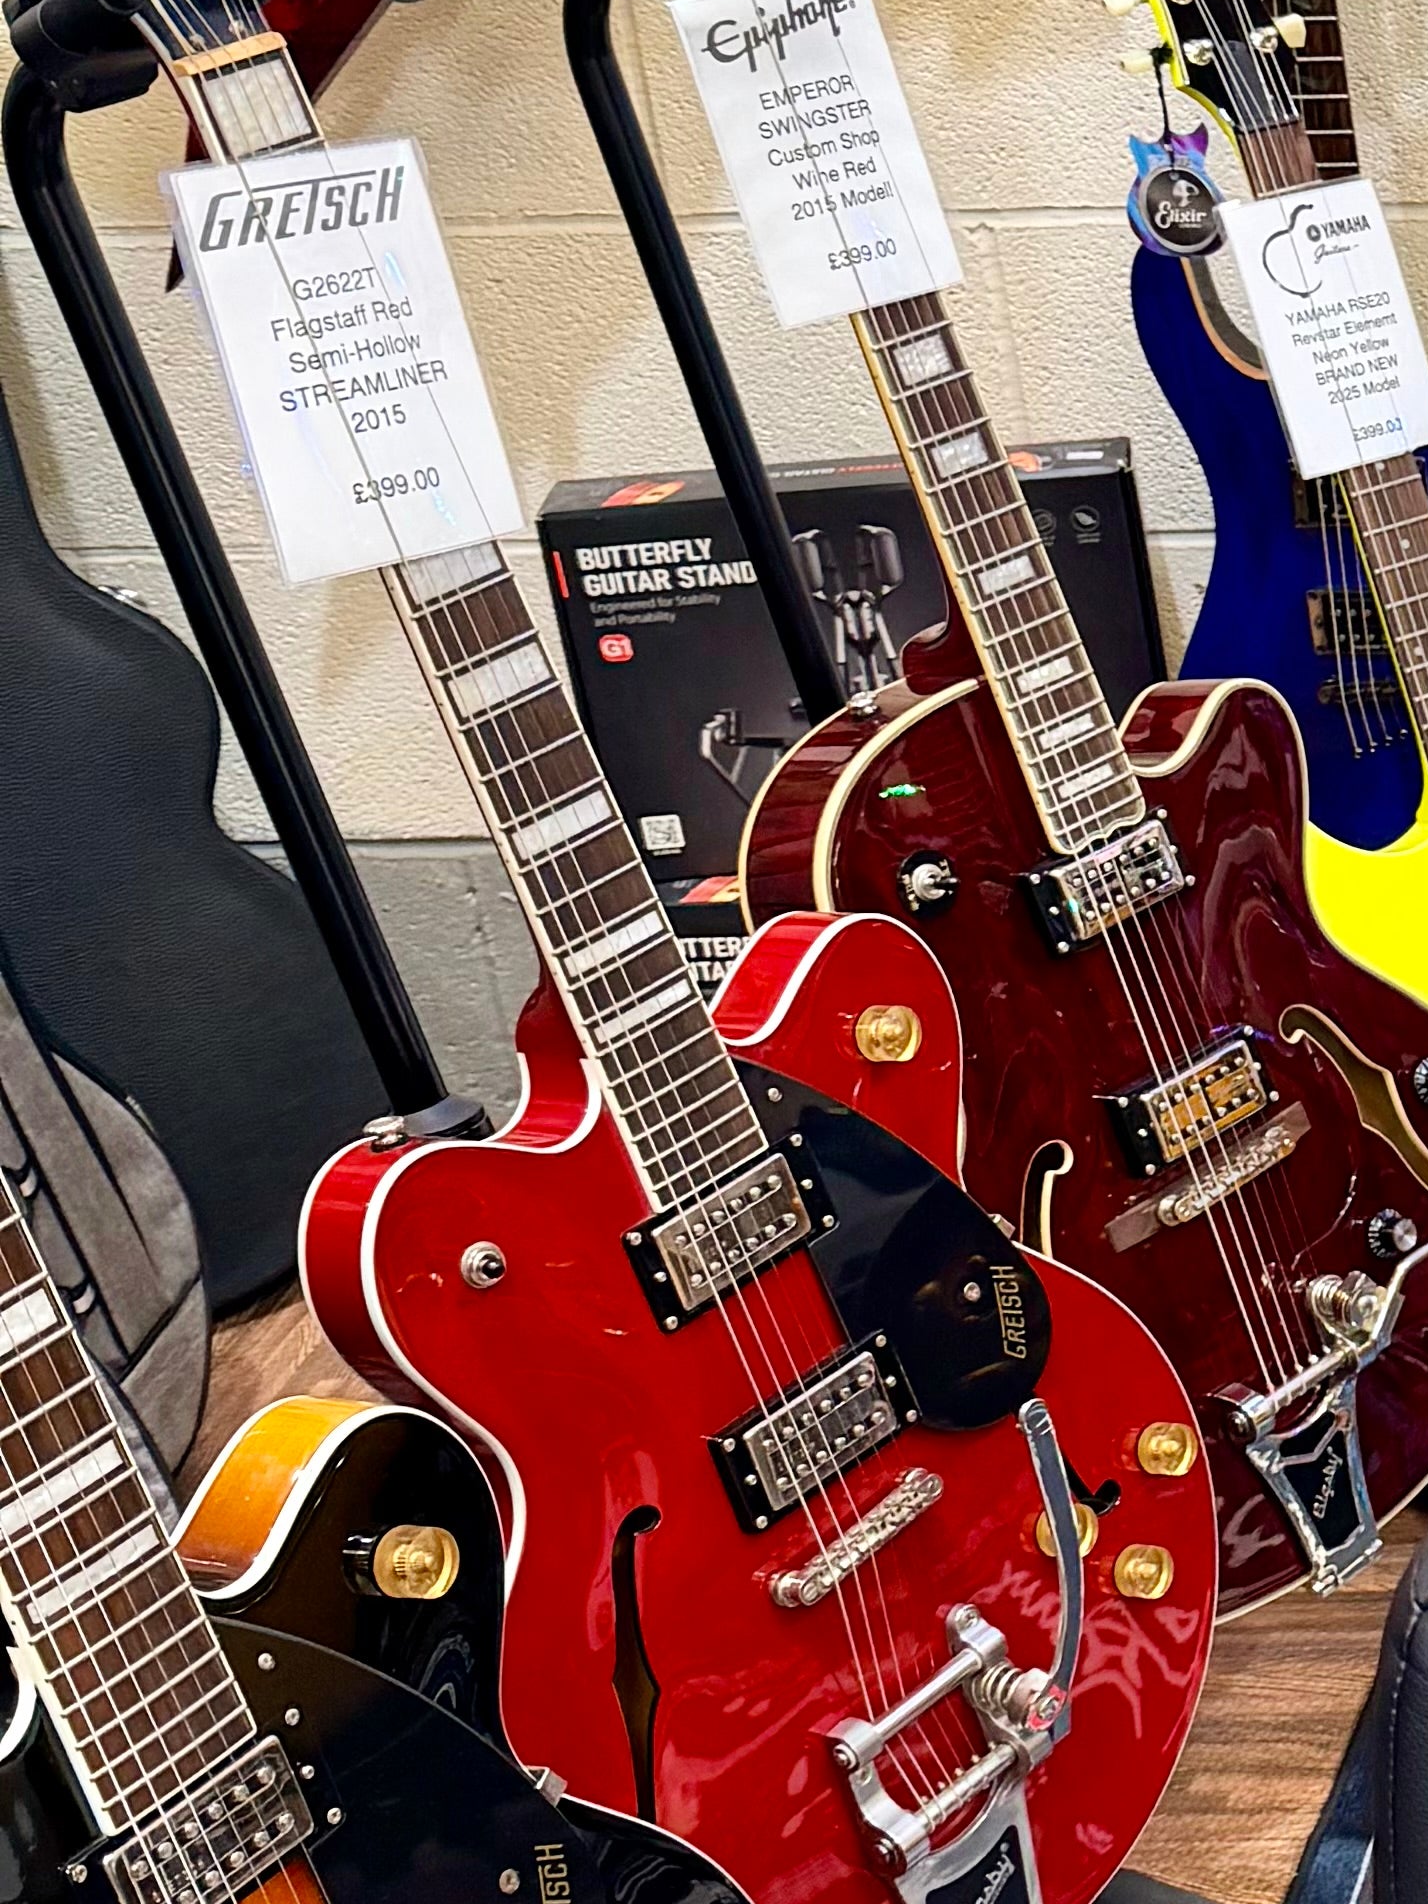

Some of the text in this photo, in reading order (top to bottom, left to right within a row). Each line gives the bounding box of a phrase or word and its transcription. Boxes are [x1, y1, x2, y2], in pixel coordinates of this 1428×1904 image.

[759, 74, 855, 110] EMPEROR
[758, 99, 873, 139] SWINGSTER
[767, 129, 881, 167] Custom Shop
[792, 157, 877, 191] Wine Red
[199, 165, 405, 252] GRETSCH
[791, 199, 837, 221] 2015
[1154, 200, 1207, 229] Elixir
[1320, 215, 1371, 238] YAMAHA
[828, 238, 898, 271] £399.00
[292, 266, 376, 301] G2622T
[270, 296, 414, 342] Flagstaff Red
[1285, 300, 1346, 326] YAMAHA
[1348, 292, 1391, 312] RSE20
[288, 333, 421, 375] Semi-Hollow
[1292, 326, 1340, 348] Revstar
[1312, 337, 1390, 366] Neon Yellow
[279, 360, 449, 413] STREAMLINER
[1316, 354, 1399, 386] BRAND NEW
[1328, 376, 1400, 404] 2025 Model
[351, 404, 408, 434] 2015
[352, 467, 441, 505] £399.00
[575, 538, 712, 571] BUTTERFLY
[583, 561, 758, 597] GUITAR STAND
[989, 1264, 1029, 1361] GRETSCH
